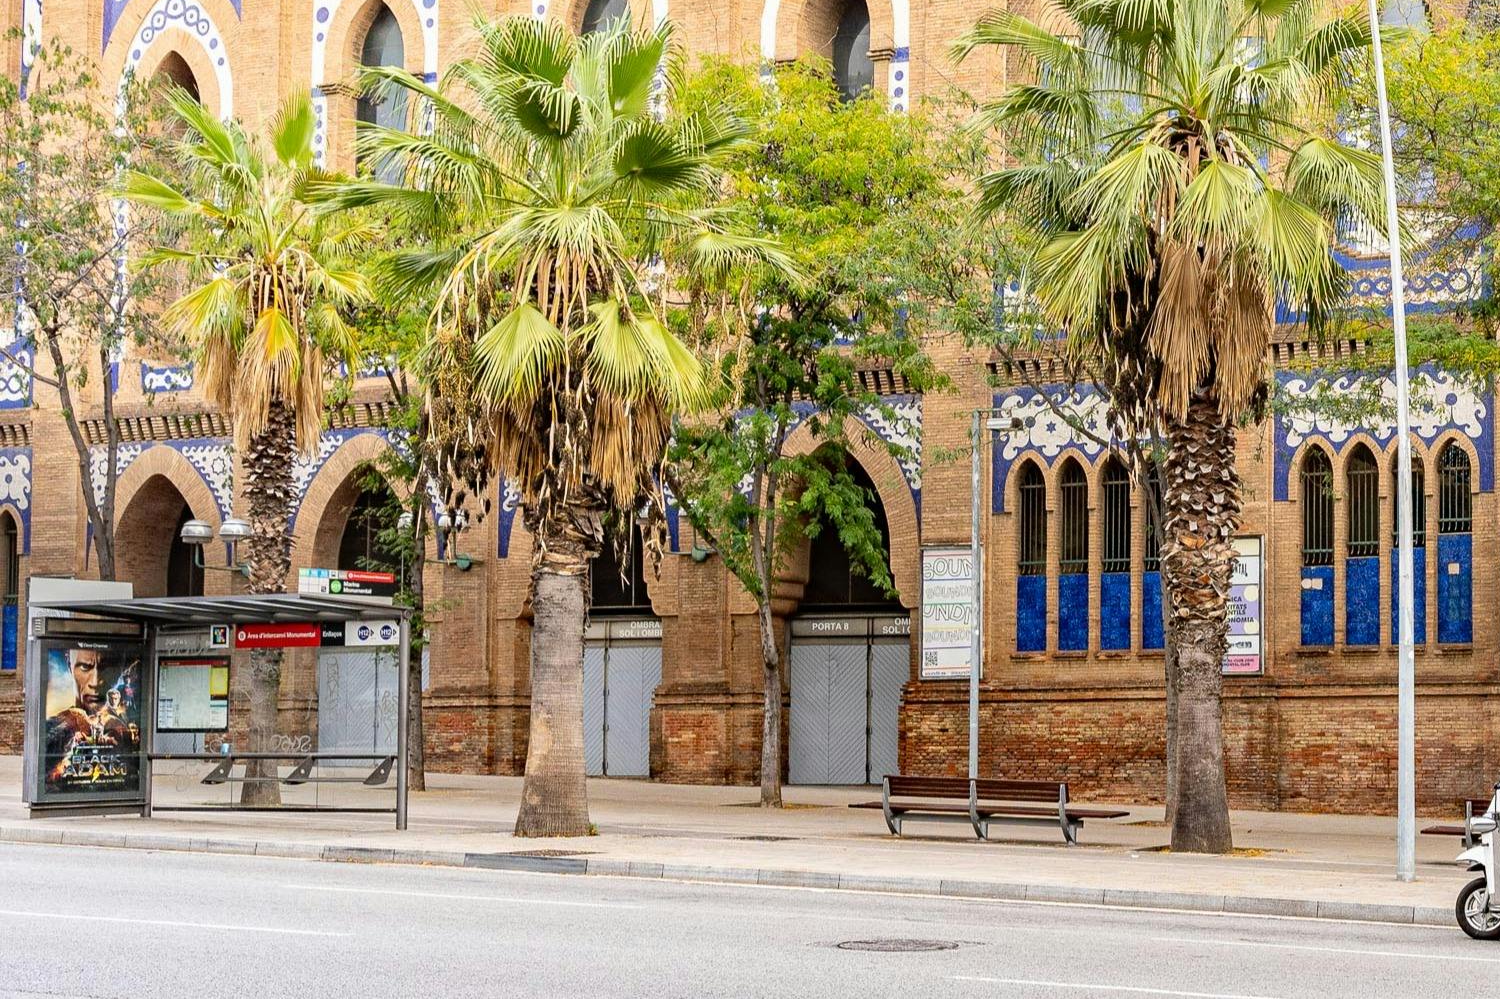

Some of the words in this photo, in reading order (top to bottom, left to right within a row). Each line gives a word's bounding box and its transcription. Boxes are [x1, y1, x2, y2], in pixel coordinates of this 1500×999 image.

[631, 621, 660, 629] OMBRA
[812, 622, 842, 631] PORTA
[843, 622, 849, 631] 8
[619, 629, 636, 638] SOL
[882, 626, 900, 634] SOL
[72, 754, 120, 764] BLACK
[62, 763, 127, 777] ADAM
